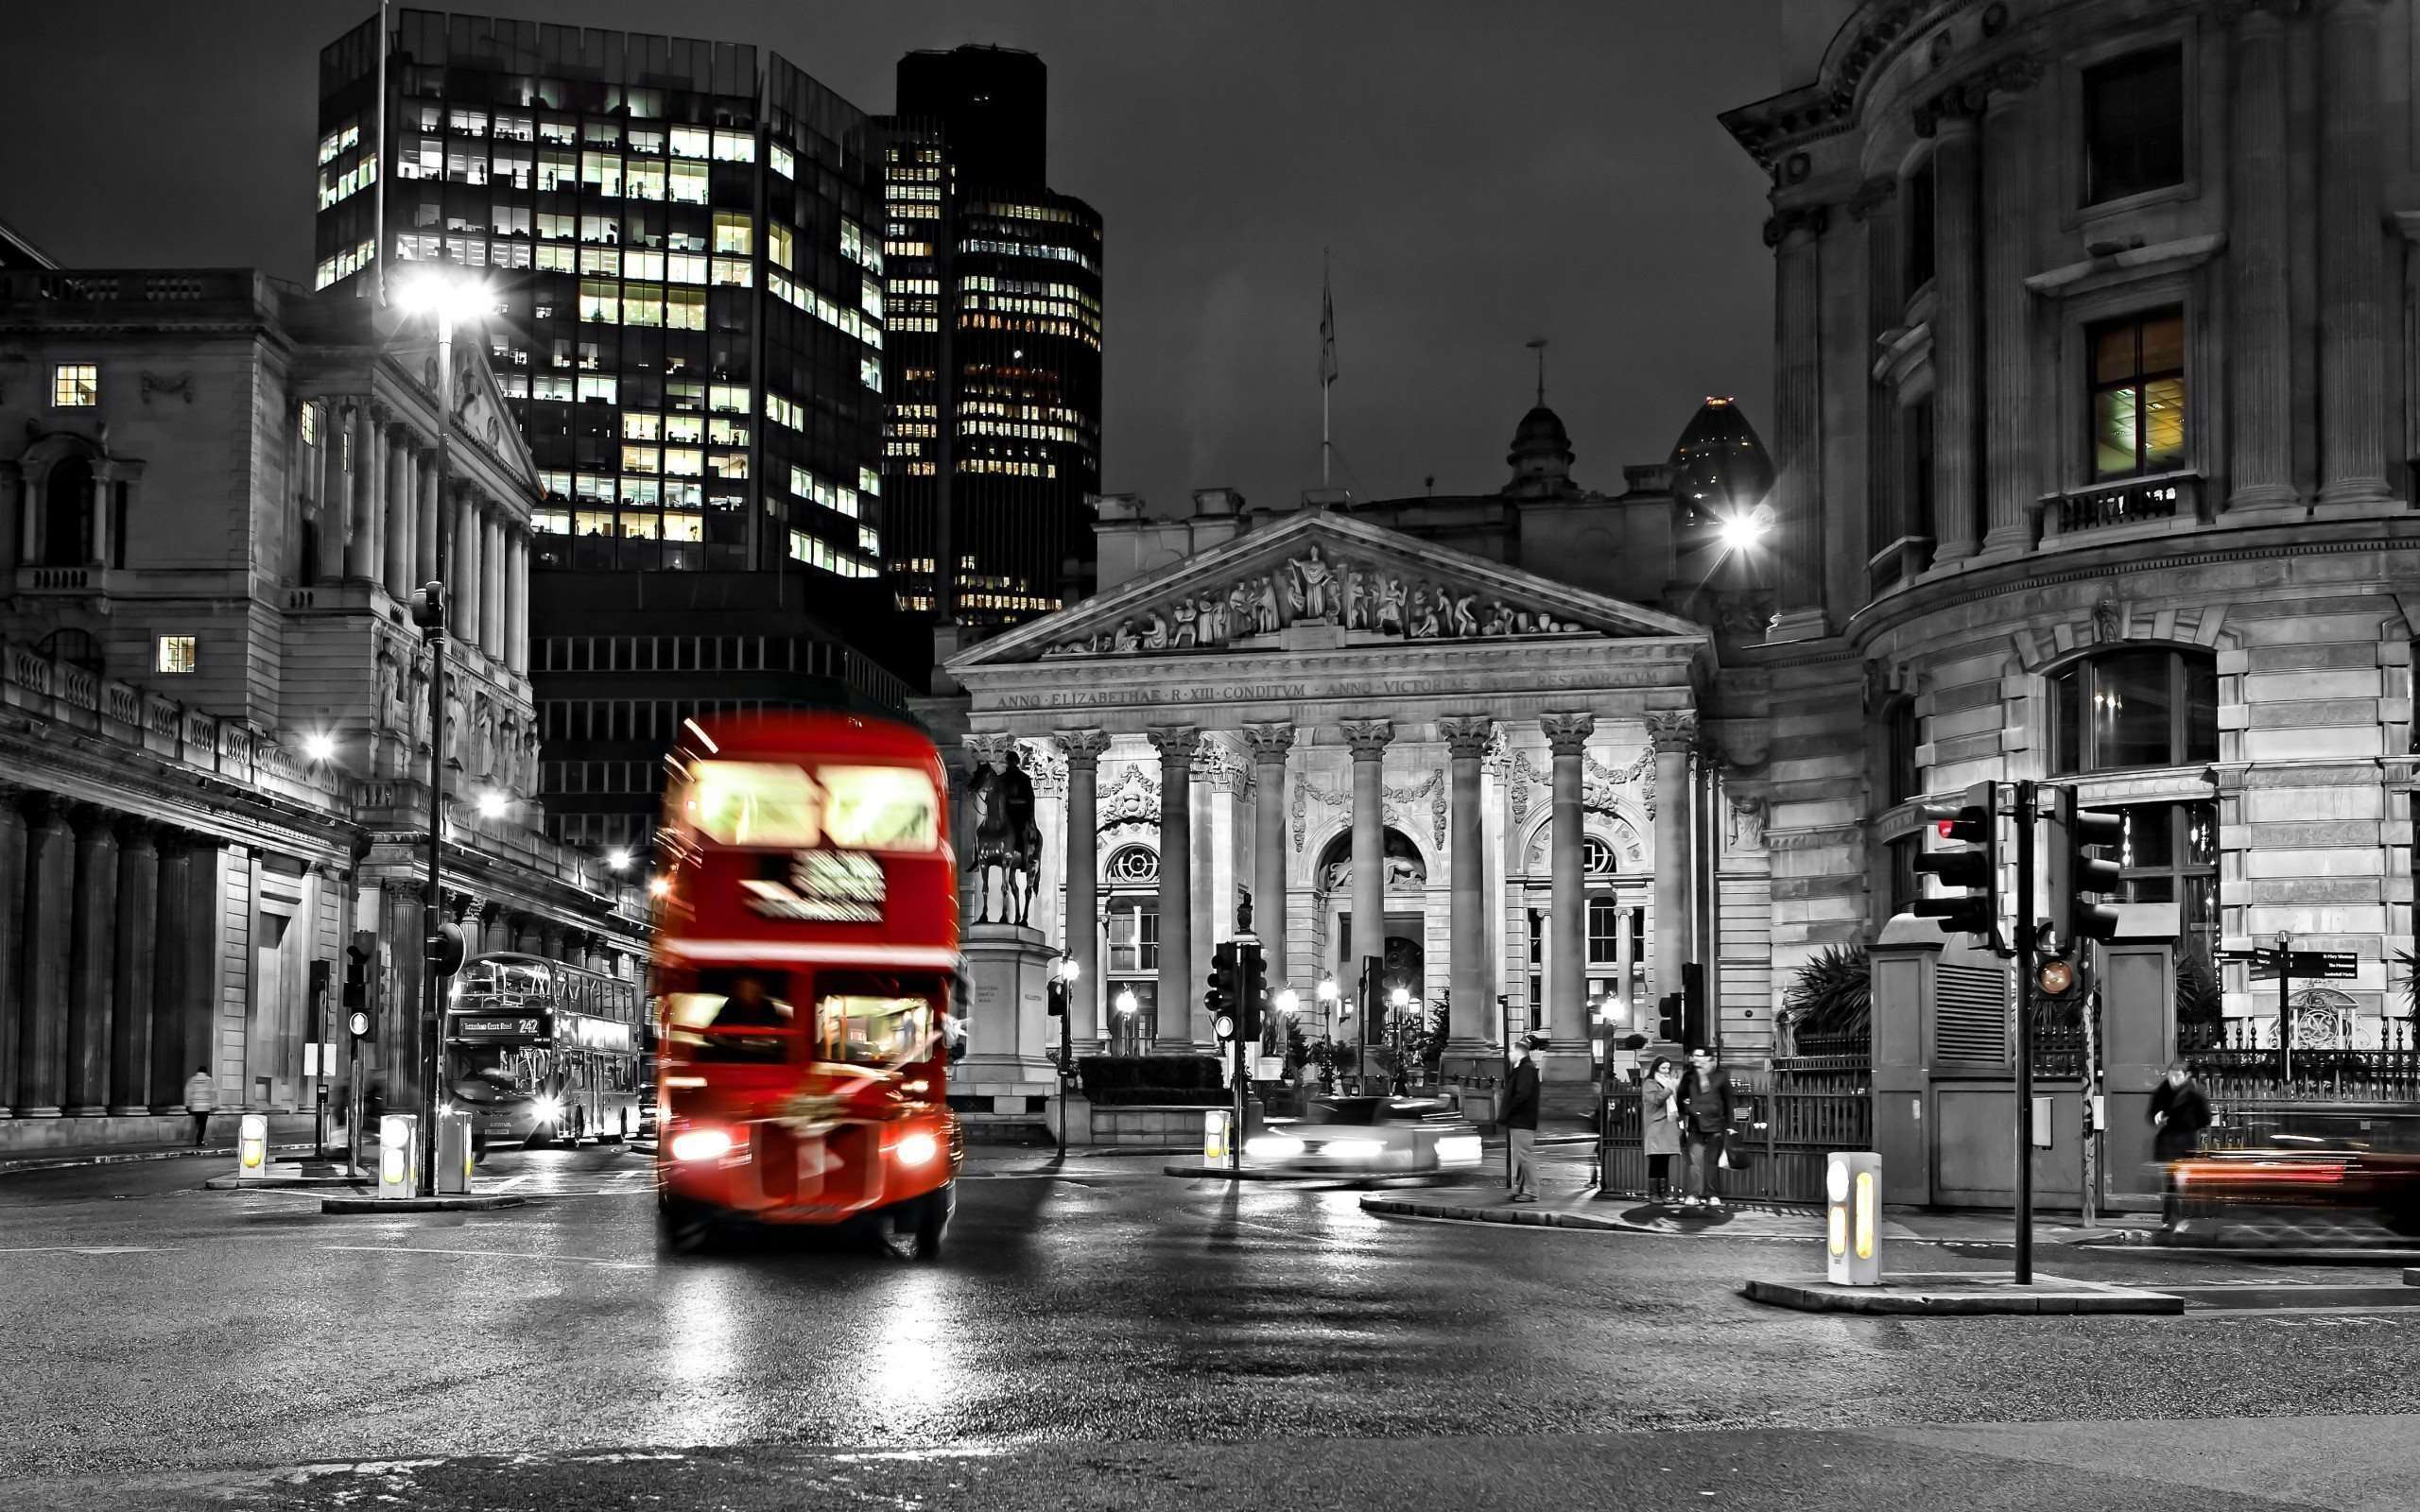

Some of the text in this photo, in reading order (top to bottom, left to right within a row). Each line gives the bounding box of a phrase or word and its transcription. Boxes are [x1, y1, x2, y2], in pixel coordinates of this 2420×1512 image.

[997, 695, 1041, 708] ANNO
[1051, 688, 1161, 706] ELIZABETHAE
[1171, 688, 1181, 701] R
[1222, 683, 1306, 699] CONDITVM
[1326, 681, 1371, 696] ANNO
[1383, 678, 1467, 694] VICTORIAE
[519, 1019, 538, 1034] 242
